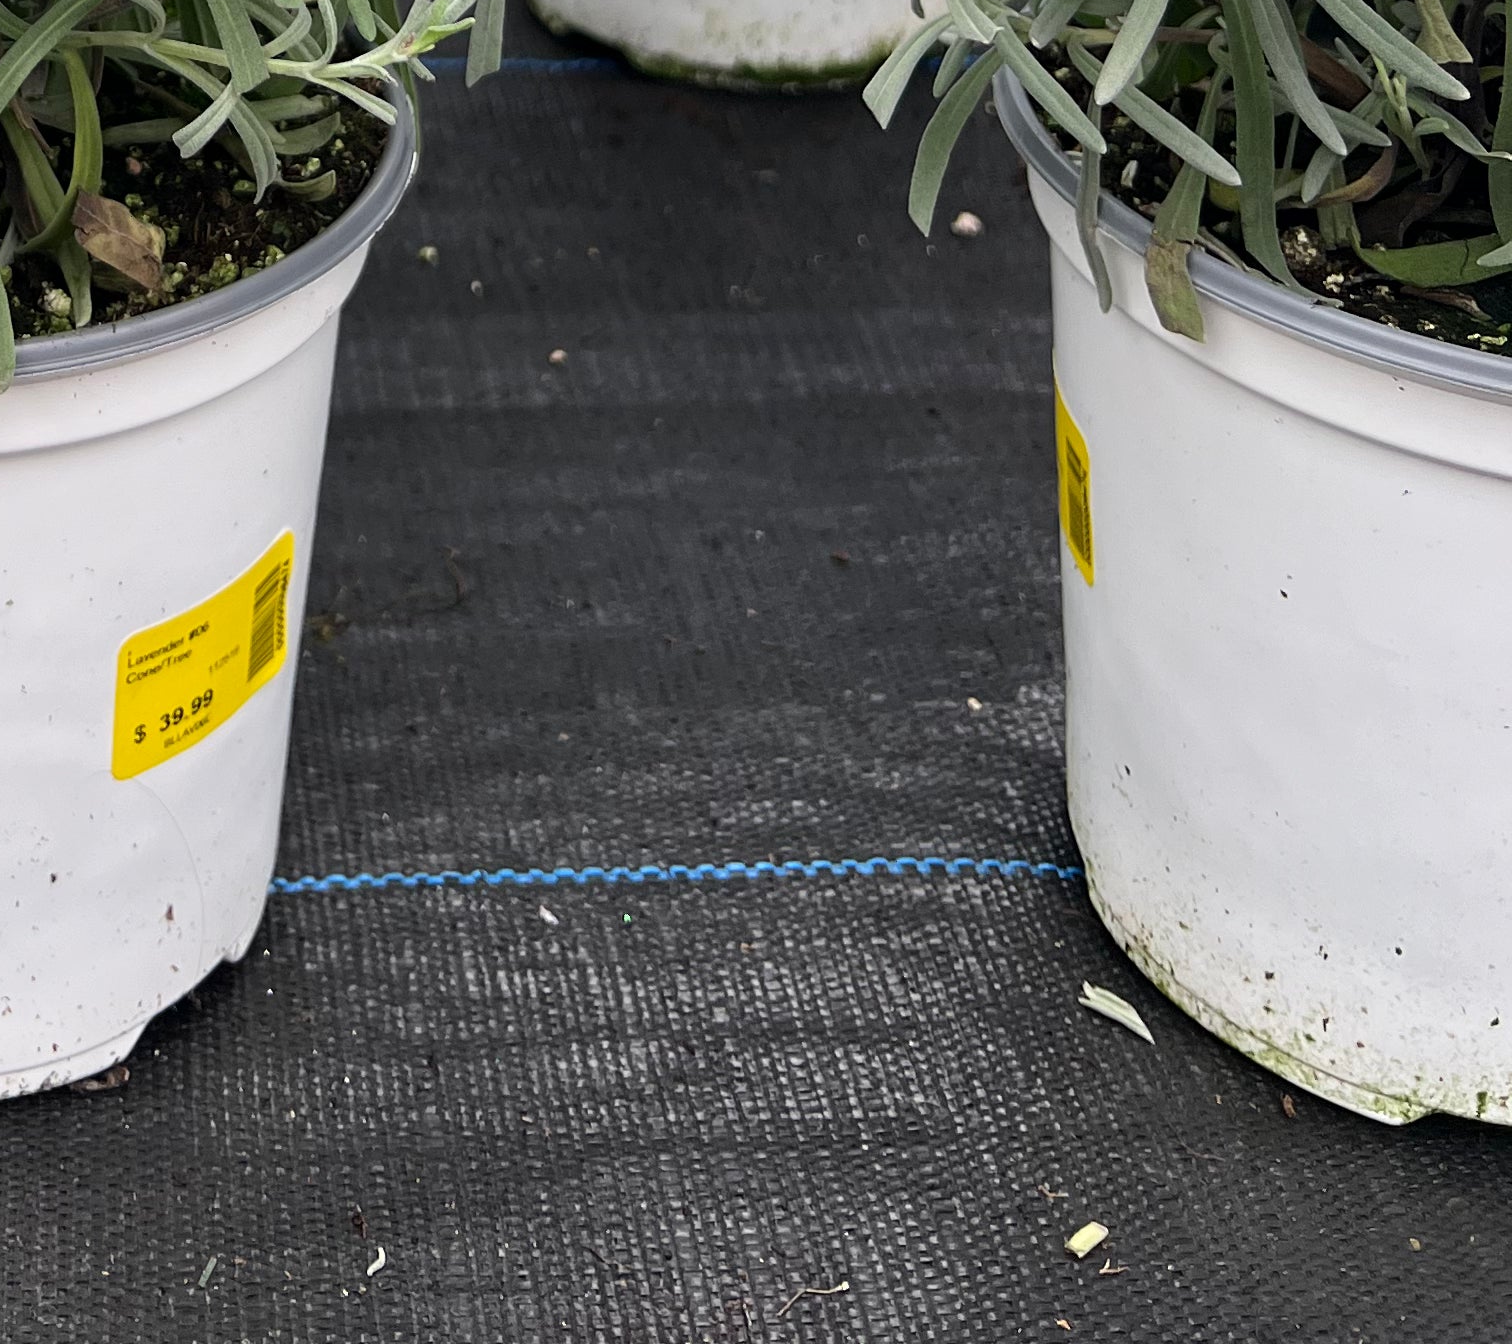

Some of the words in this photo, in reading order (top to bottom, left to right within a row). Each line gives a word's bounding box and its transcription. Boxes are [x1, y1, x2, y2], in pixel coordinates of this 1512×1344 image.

[127, 637, 184, 669] Lavender
[134, 723, 146, 744] $
[159, 688, 213, 732] 39.99
